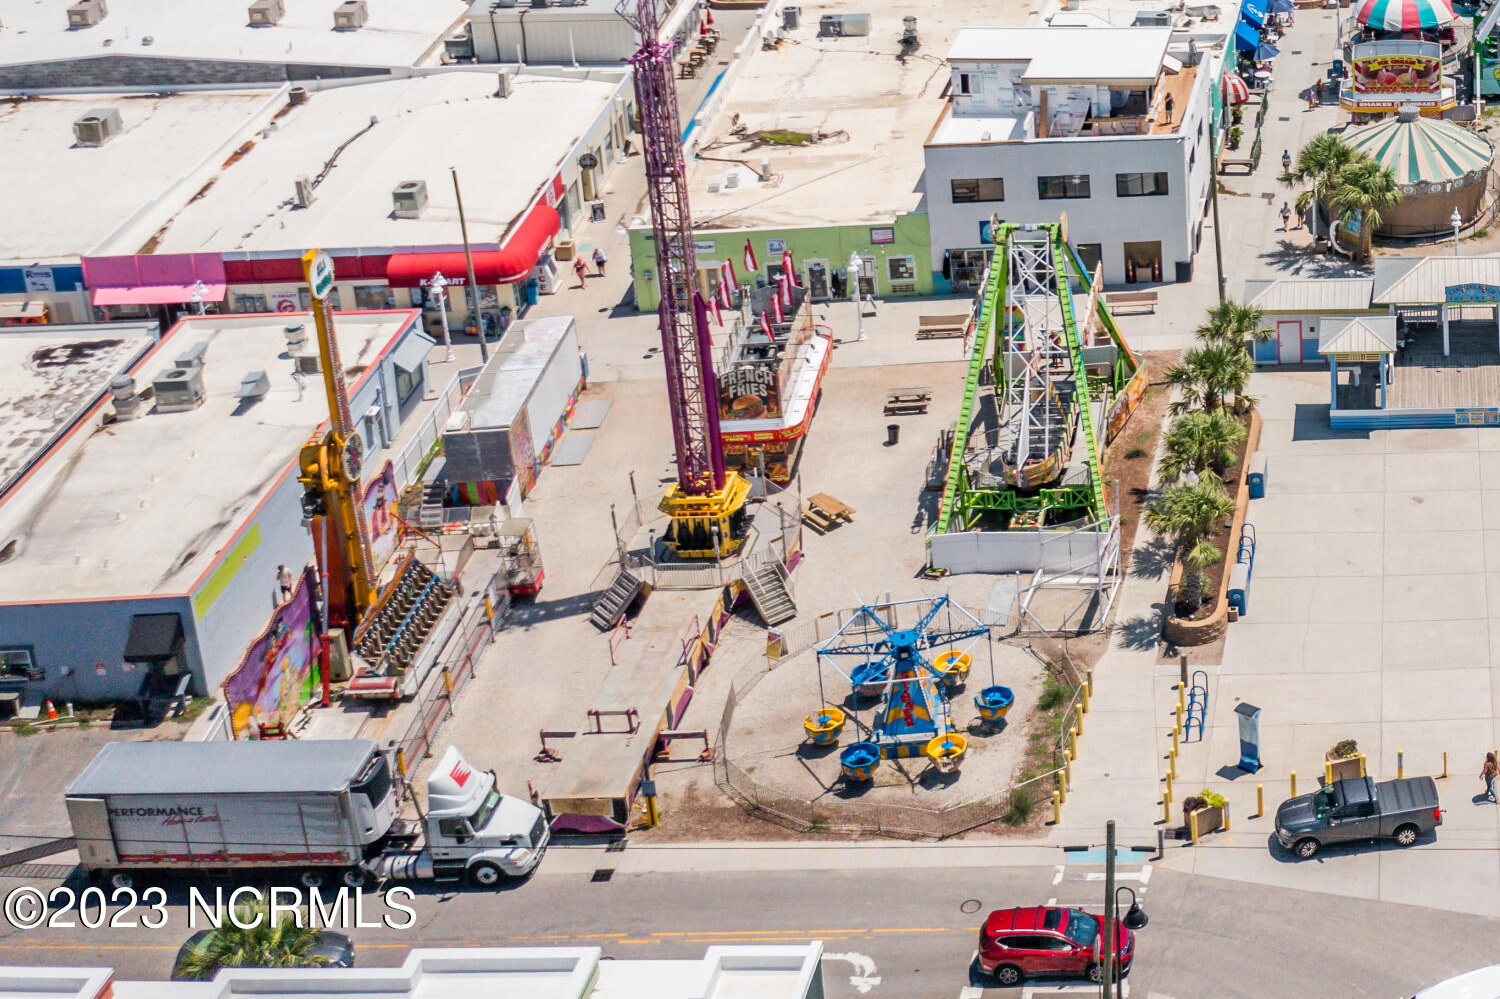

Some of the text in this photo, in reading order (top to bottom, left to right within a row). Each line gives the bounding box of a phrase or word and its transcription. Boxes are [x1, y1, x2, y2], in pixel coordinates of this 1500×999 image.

[721, 368, 774, 389] FRENCH
[729, 383, 768, 399] FRIES
[107, 806, 204, 817] PERFORMANCE
